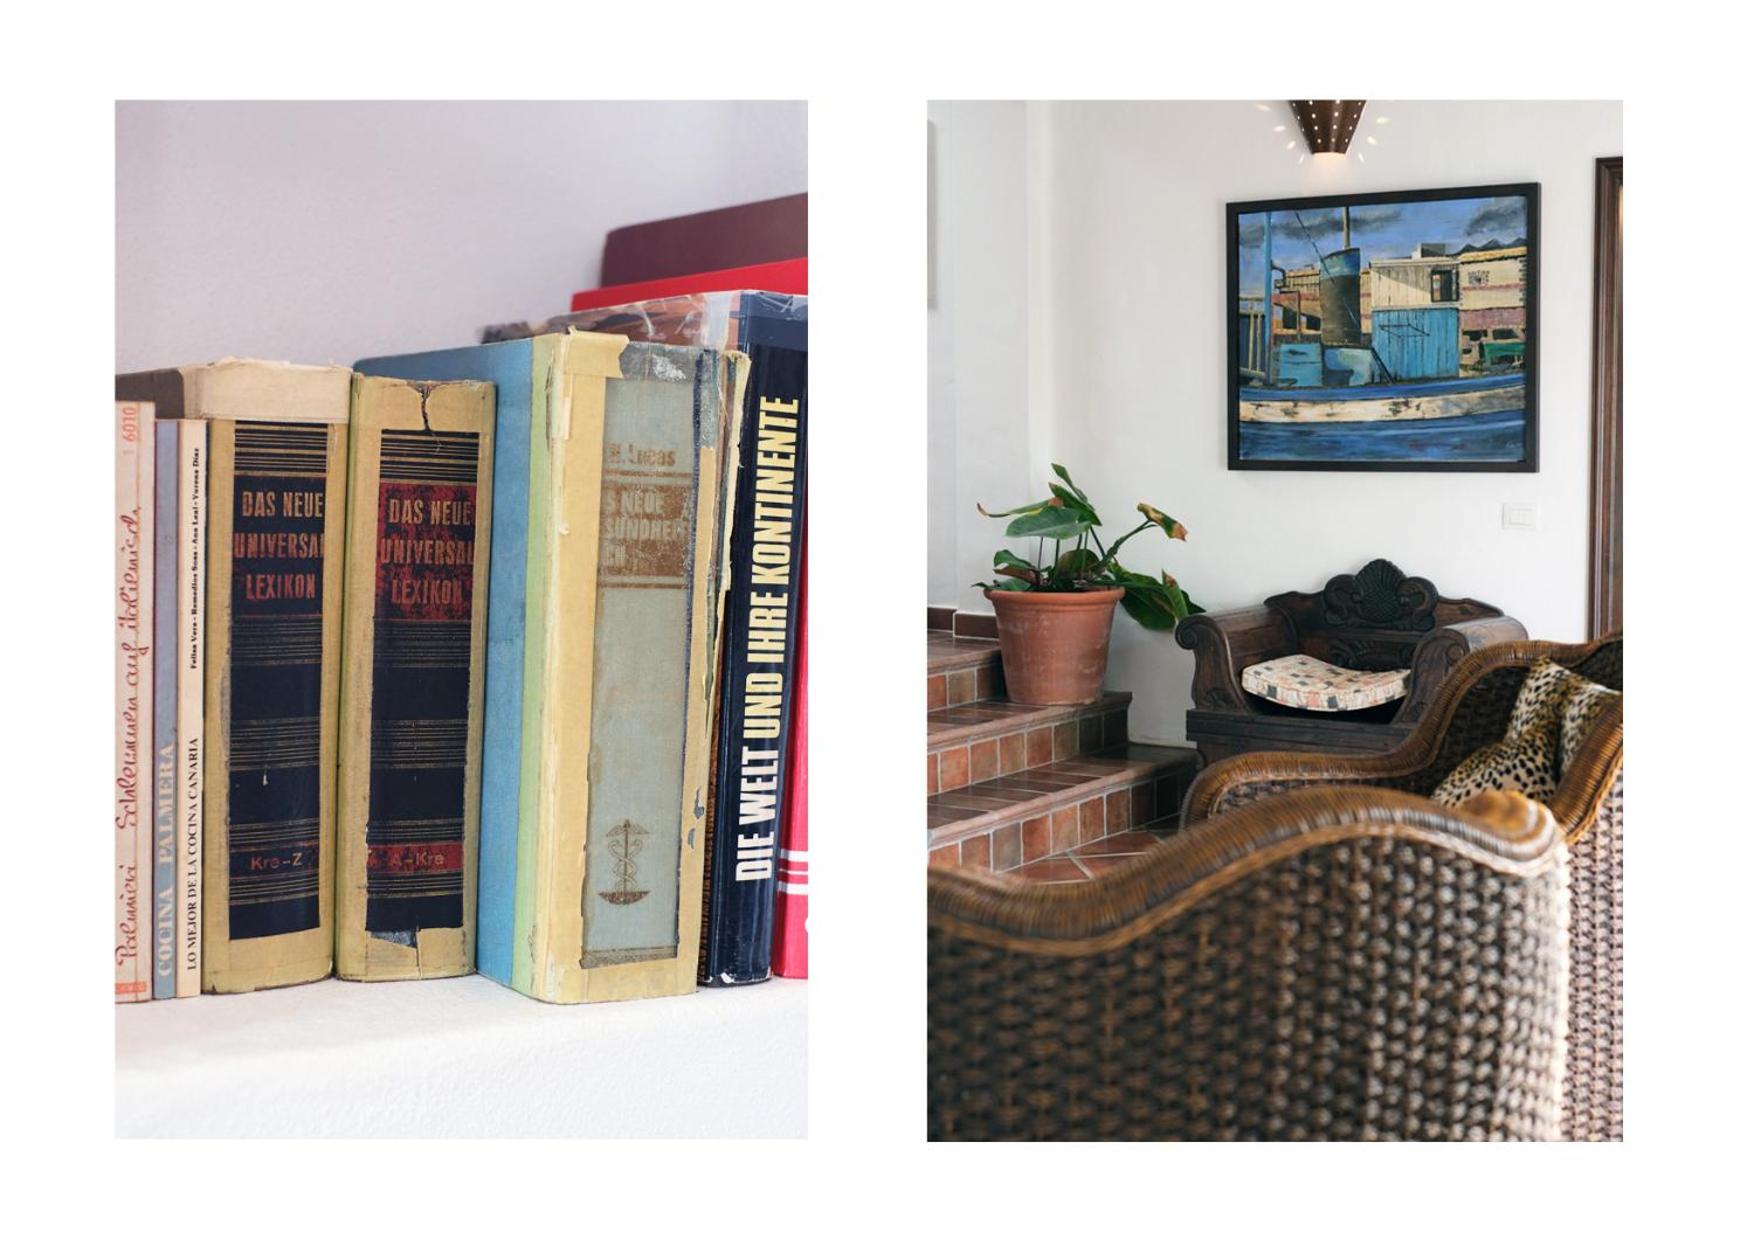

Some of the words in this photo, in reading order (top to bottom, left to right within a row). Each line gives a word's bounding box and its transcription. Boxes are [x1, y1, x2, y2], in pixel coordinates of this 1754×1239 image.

[122, 406, 137, 442] 6010
[242, 491, 276, 517] DAS
[283, 491, 324, 518] NEUE
[388, 499, 424, 524] DAS
[431, 500, 472, 526] NEUE
[751, 396, 798, 585] KONTINENTE
[245, 574, 316, 599] LEXIKON
[391, 577, 464, 605] LEXIKON
[747, 592, 788, 664] IHRE
[121, 642, 149, 686] auf
[743, 672, 783, 739] UND
[188, 738, 199, 799] CANARIA
[739, 746, 779, 825] WELT
[158, 742, 175, 864] PALMERA
[187, 803, 198, 855] COCINA
[187, 859, 198, 876] LA
[251, 851, 303, 872] Kre-Z
[736, 832, 775, 882] DIE
[187, 882, 198, 898] DE
[158, 887, 175, 977] COCINA
[187, 901, 197, 949] MEJOR
[187, 951, 197, 970] LO
